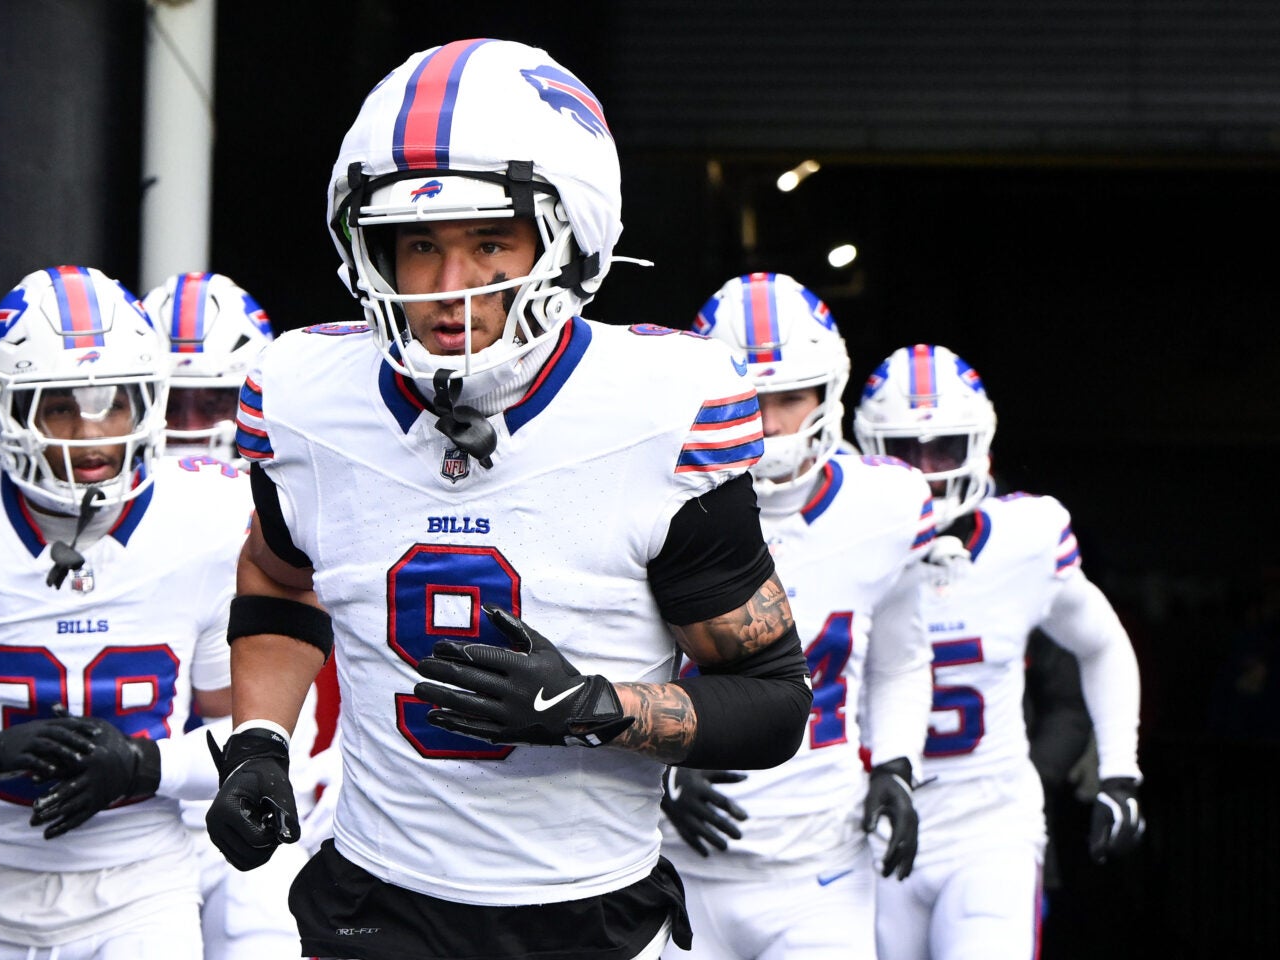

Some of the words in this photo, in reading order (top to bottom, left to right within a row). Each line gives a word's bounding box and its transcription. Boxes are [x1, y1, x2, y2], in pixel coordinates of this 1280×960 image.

[445, 460, 465, 476] NFL
[427, 516, 491, 534] BILLS
[57, 619, 110, 634] BILLS
[922, 636, 986, 759] 5
